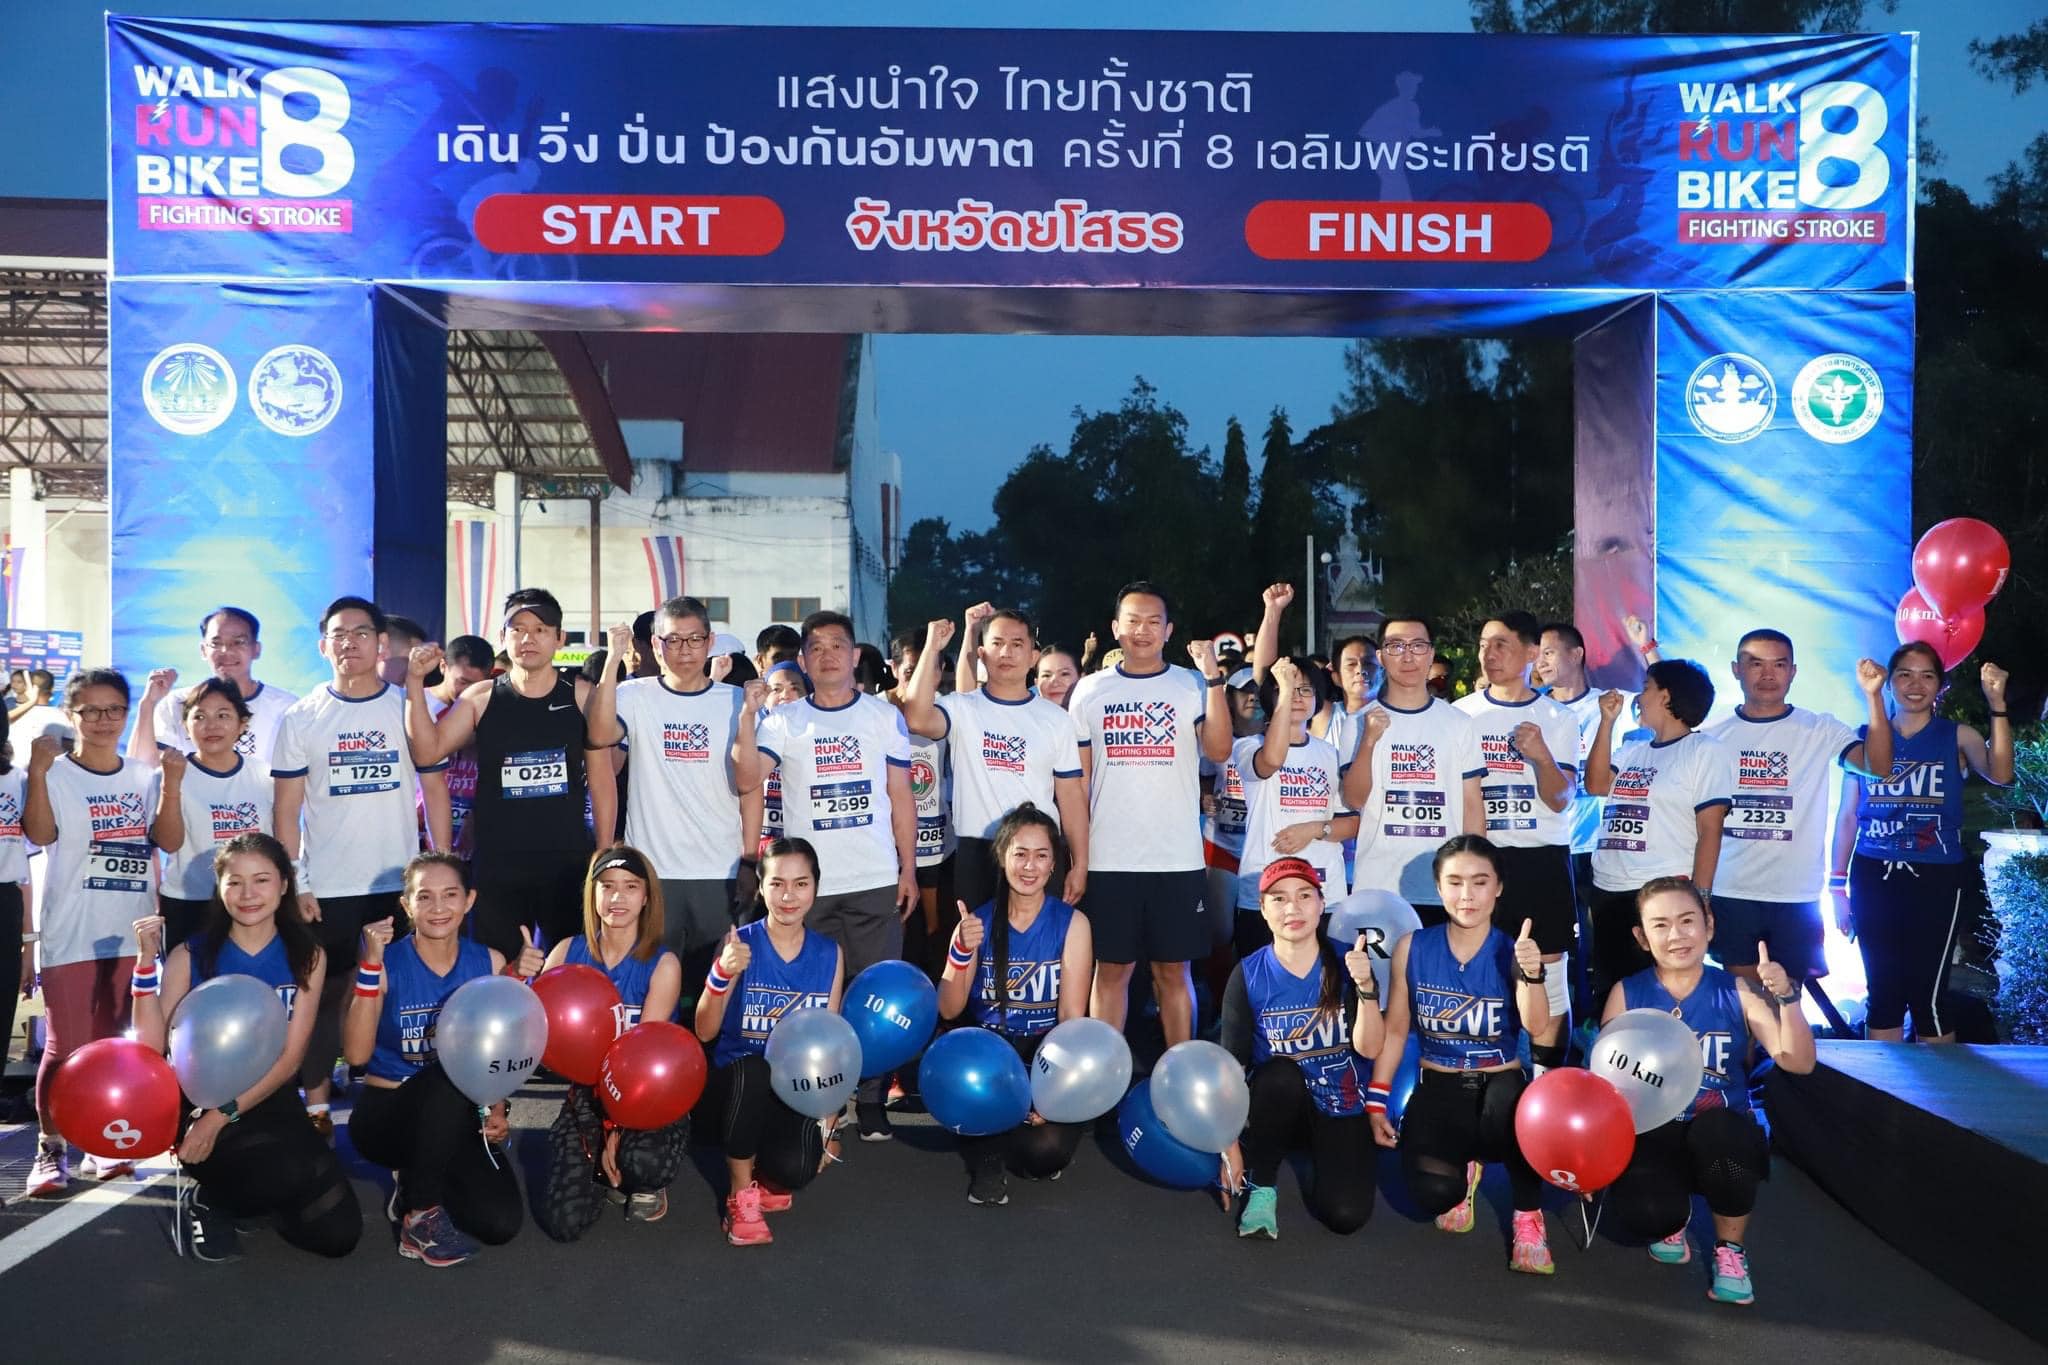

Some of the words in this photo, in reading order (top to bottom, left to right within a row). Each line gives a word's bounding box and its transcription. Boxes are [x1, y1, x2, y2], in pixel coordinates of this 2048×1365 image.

[134, 65, 258, 99] WALK
[777, 65, 979, 111] แสงนำใจ
[1000, 57, 1253, 113] ไทยทั้งชาติ
[1680, 82, 1796, 114] WALK
[135, 104, 257, 148] RUN
[258, 67, 355, 197] 8
[438, 125, 518, 163] เดิน
[539, 112, 598, 163] วิ่ง
[618, 113, 685, 164] ปั่น
[705, 124, 1033, 167] ป้องกันอัมพาต
[1064, 119, 1182, 169] ครั้งที่
[1206, 134, 1235, 169] 8
[1256, 134, 1589, 173] เฉลิมพระเกียรติ
[1679, 118, 1796, 162] RUN
[1799, 81, 1891, 209] 8
[136, 155, 260, 196] BIKE
[1678, 170, 1796, 208] BIKE
[150, 205, 253, 226] FIGHTING
[258, 206, 341, 227] STROKE
[542, 205, 720, 246] START
[847, 197, 1183, 253] จังหวัดยโสธร
[1689, 218, 1788, 239] FIGHTING
[1795, 217, 1875, 238] STROKE
[1309, 213, 1492, 253] FINISH
[1104, 702, 1143, 714] WALK
[1103, 715, 1143, 730] RUN
[338, 731, 365, 740] WALK
[664, 730, 688, 740] RUN
[815, 736, 840, 744] WALK
[983, 731, 1006, 741] WALK
[1104, 732, 1144, 745] BIKE
[338, 740, 365, 750] RUN
[664, 741, 688, 750] BIKE
[815, 744, 840, 755] RUN
[984, 739, 1006, 750] RUN
[1481, 742, 1507, 752] RUN
[983, 750, 1008, 759] BIKE
[1108, 748, 1142, 756] FIGHTING
[1143, 748, 1171, 756] STROKE
[1392, 752, 1416, 762] RUN
[816, 755, 842, 765] BIKE
[1739, 758, 1768, 768] RUN
[351, 765, 392, 779] 1729
[519, 764, 562, 781] 0232
[1392, 763, 1416, 771] BIKE
[1740, 768, 1767, 778] BIKE
[1280, 774, 1308, 785] RUN
[1616, 780, 1638, 788] BIKE
[1280, 786, 1310, 797] BIKE
[86, 793, 118, 804] WALK
[827, 796, 869, 812] 2699
[89, 804, 122, 817] RUN
[1402, 807, 1441, 820] 0015
[1488, 800, 1531, 814] 3930
[212, 811, 237, 820] RUN
[1743, 810, 1786, 823] 2323
[92, 817, 124, 831] BIKE
[213, 821, 240, 830] BIKE
[1608, 820, 1643, 834] 0505
[105, 859, 147, 874] 0833
[744, 1004, 765, 1016] JUST
[864, 994, 885, 1013] 10
[883, 1007, 912, 1030] km
[1418, 1003, 1435, 1017] JUST
[402, 1027, 424, 1039] JUST
[1266, 1028, 1284, 1040] JUST
[489, 1060, 500, 1074] 5
[507, 1055, 533, 1073] km
[1608, 1049, 1627, 1070] 10
[1632, 1061, 1664, 1089] km
[792, 1078, 810, 1092] 10
[816, 1071, 844, 1090] km
